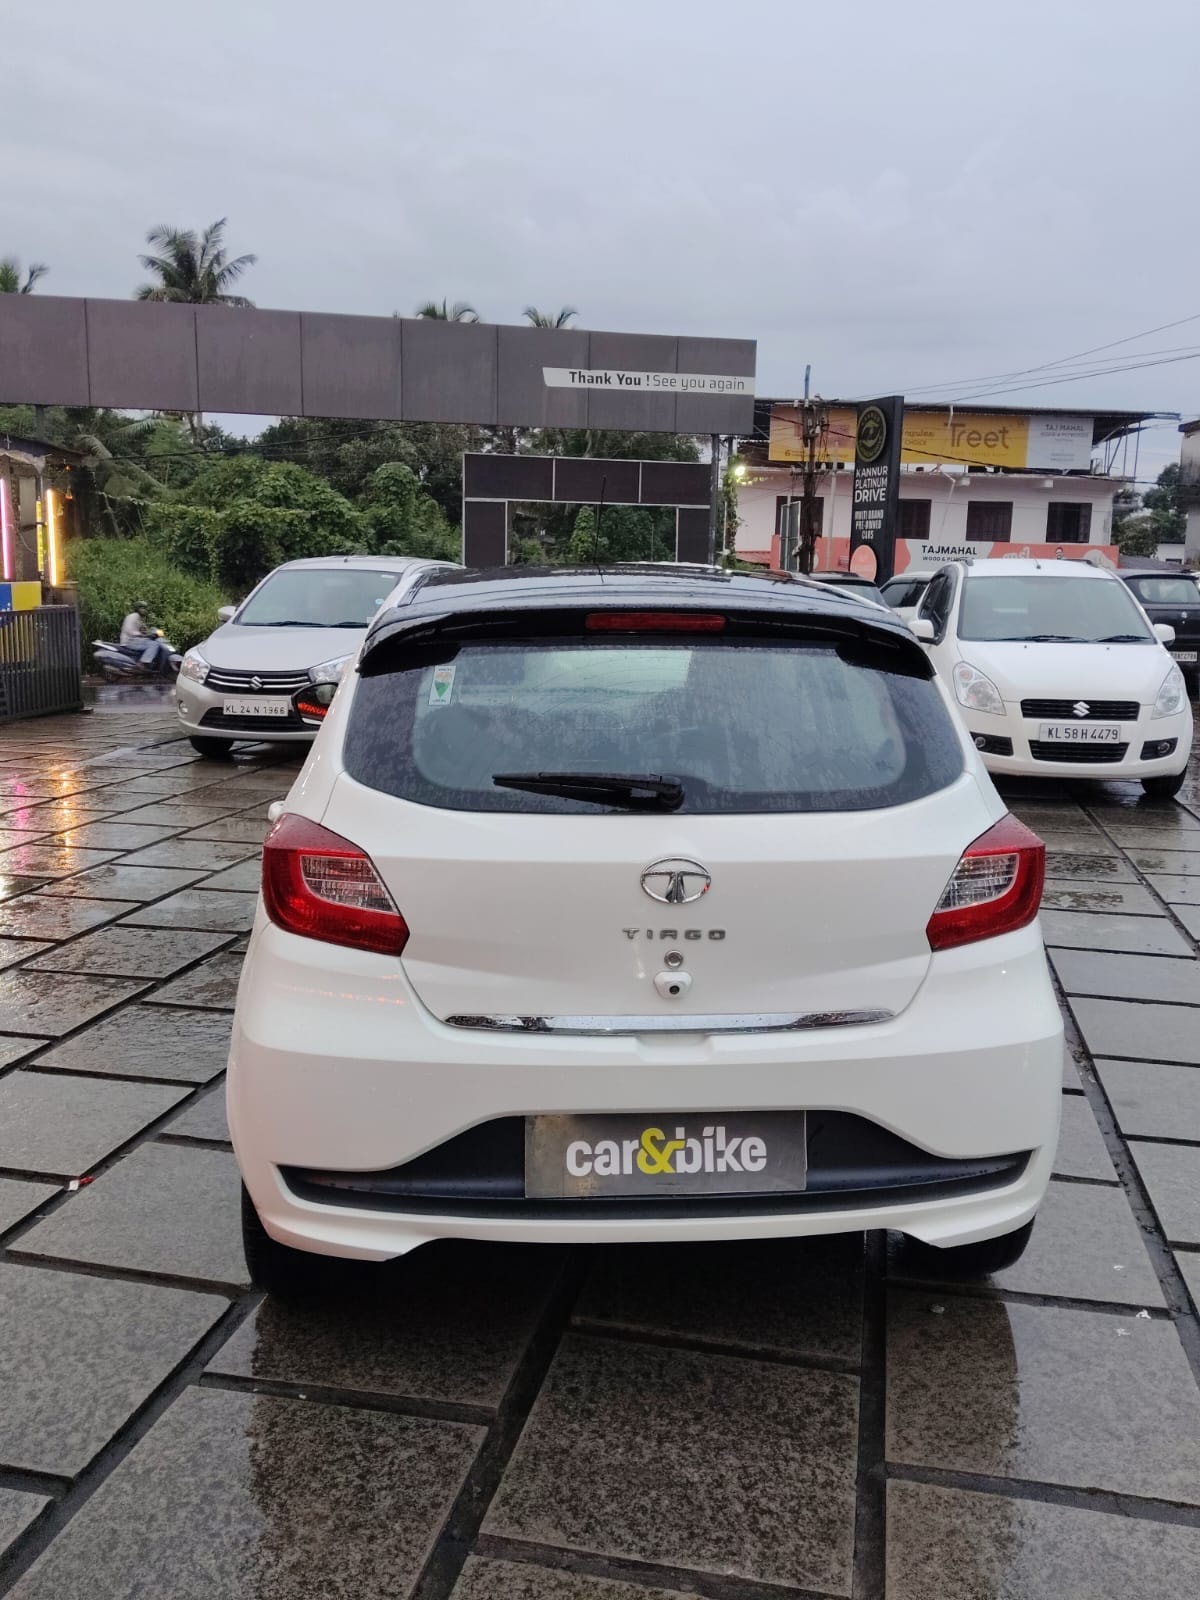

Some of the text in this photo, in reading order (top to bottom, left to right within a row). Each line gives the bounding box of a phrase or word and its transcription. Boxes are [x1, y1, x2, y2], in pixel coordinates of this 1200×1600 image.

[569, 371, 612, 385] Thank
[616, 373, 641, 386] You
[653, 375, 676, 387] See
[681, 379, 705, 390] you
[709, 378, 745, 392] again
[1045, 423, 1058, 431] TAJ
[944, 422, 1009, 449] Treet
[856, 465, 888, 478] KANNUR
[855, 477, 888, 489] PLATINUM
[854, 487, 887, 503] DRIVE
[921, 545, 977, 555] TAJMAHAL
[225, 704, 237, 713] KL
[240, 705, 251, 713] 24
[1047, 727, 1119, 740] KL 58 H 4479
[622, 928, 726, 941] TIAGO
[566, 1126, 767, 1177] car&bike
